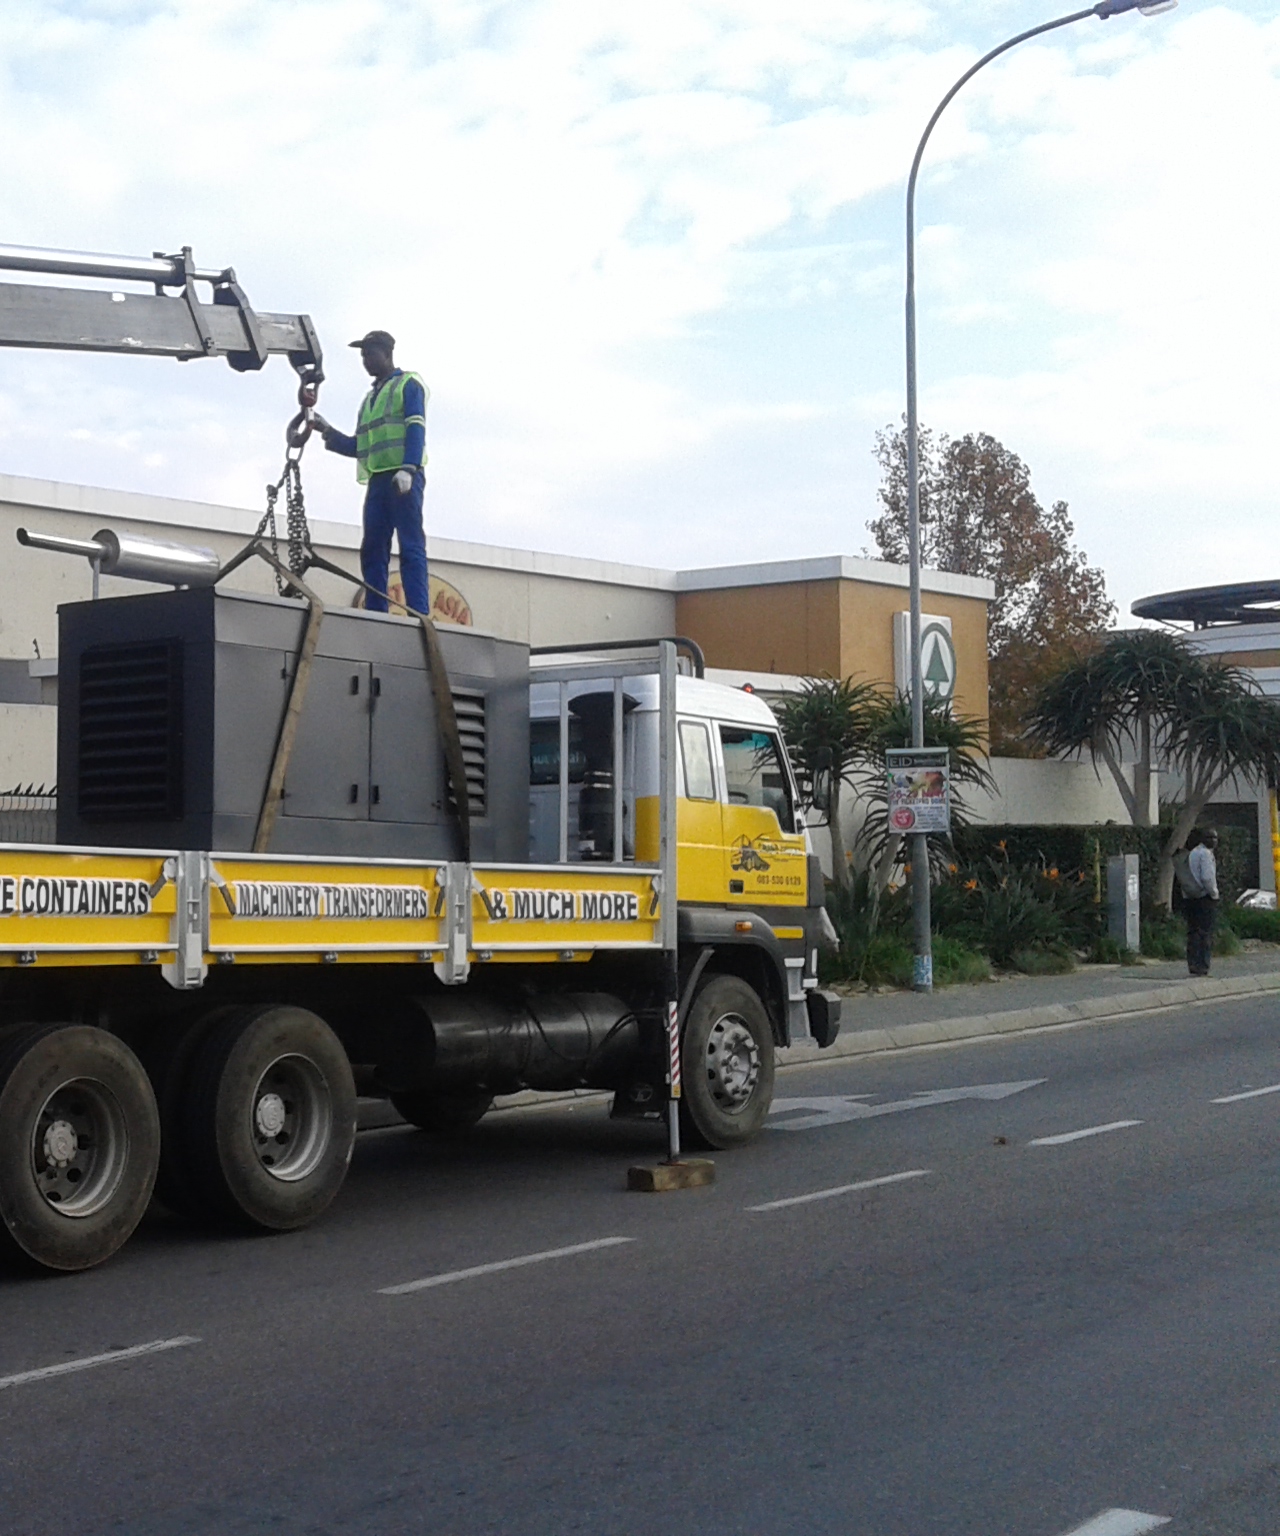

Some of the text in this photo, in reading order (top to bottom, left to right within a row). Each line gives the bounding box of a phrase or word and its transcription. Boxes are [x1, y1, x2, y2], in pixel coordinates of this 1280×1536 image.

[433, 590, 470, 626] ASIA
[21, 877, 150, 915] CONTAINERS
[236, 883, 428, 919] MACHINERY TRANSFORMERS
[491, 890, 638, 920] & MUCH MORE
